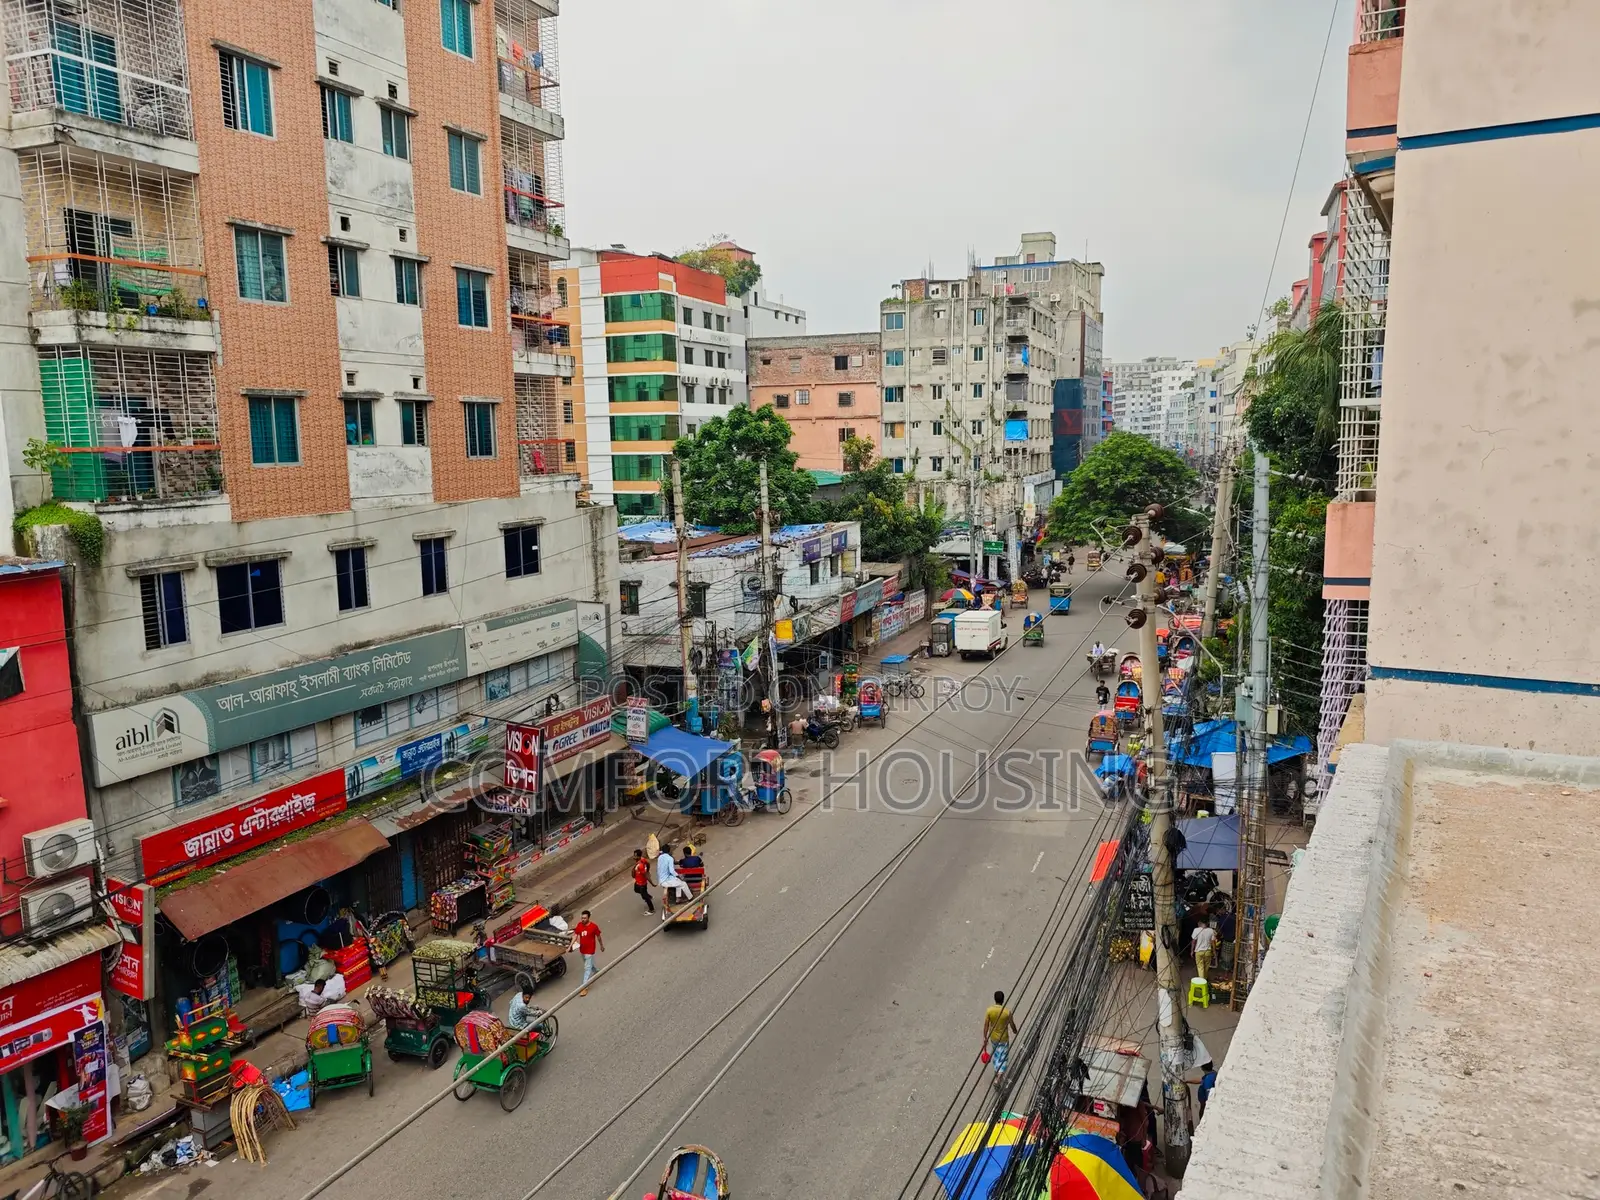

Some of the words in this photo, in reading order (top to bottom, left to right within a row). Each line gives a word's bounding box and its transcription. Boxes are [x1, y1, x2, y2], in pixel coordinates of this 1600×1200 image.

[216, 680, 299, 712] আল-আরাফাহ্
[299, 666, 340, 691] ইসলামী
[342, 661, 370, 680] ব্যাংক
[372, 651, 411, 673] লিমিটেড
[582, 700, 611, 722] VISION
[115, 725, 149, 751] aibl
[507, 730, 538, 756] VISION
[560, 731, 578, 748] GREE
[590, 718, 610, 736] WALTON
[506, 759, 537, 791] ভিশন
[183, 823, 235, 858] জান্নাত
[240, 793, 317, 837] এন্টারপ্রাইজ
